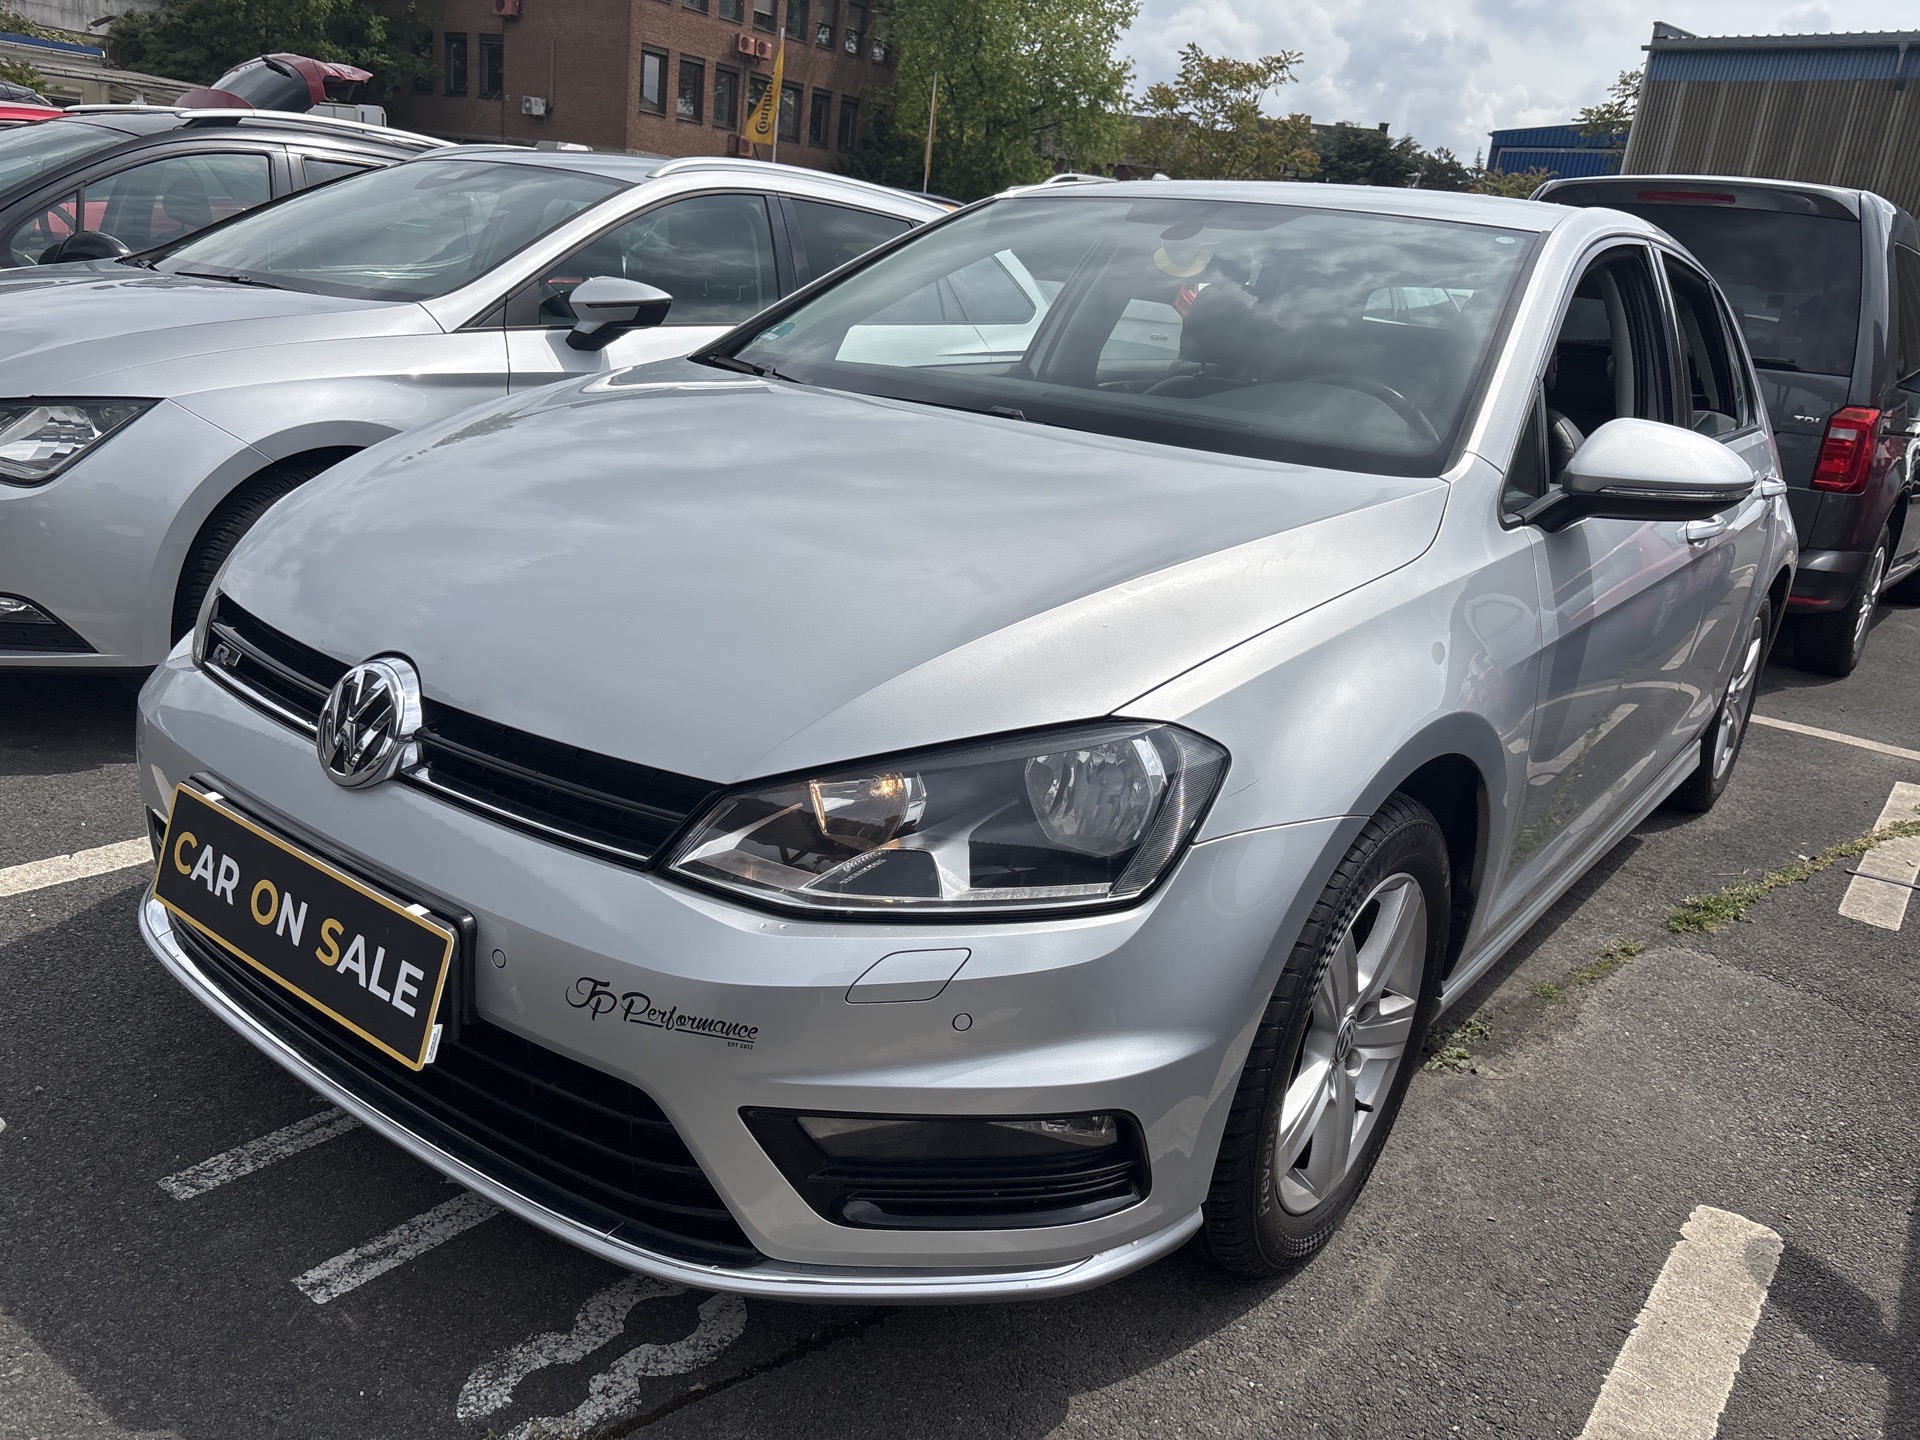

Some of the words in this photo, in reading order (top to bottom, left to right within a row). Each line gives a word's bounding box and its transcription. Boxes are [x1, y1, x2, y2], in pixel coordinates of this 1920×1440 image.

[174, 831, 240, 906] CAR
[250, 879, 308, 947] ON
[315, 917, 425, 1018] SALE
[620, 991, 759, 1041] Performance
